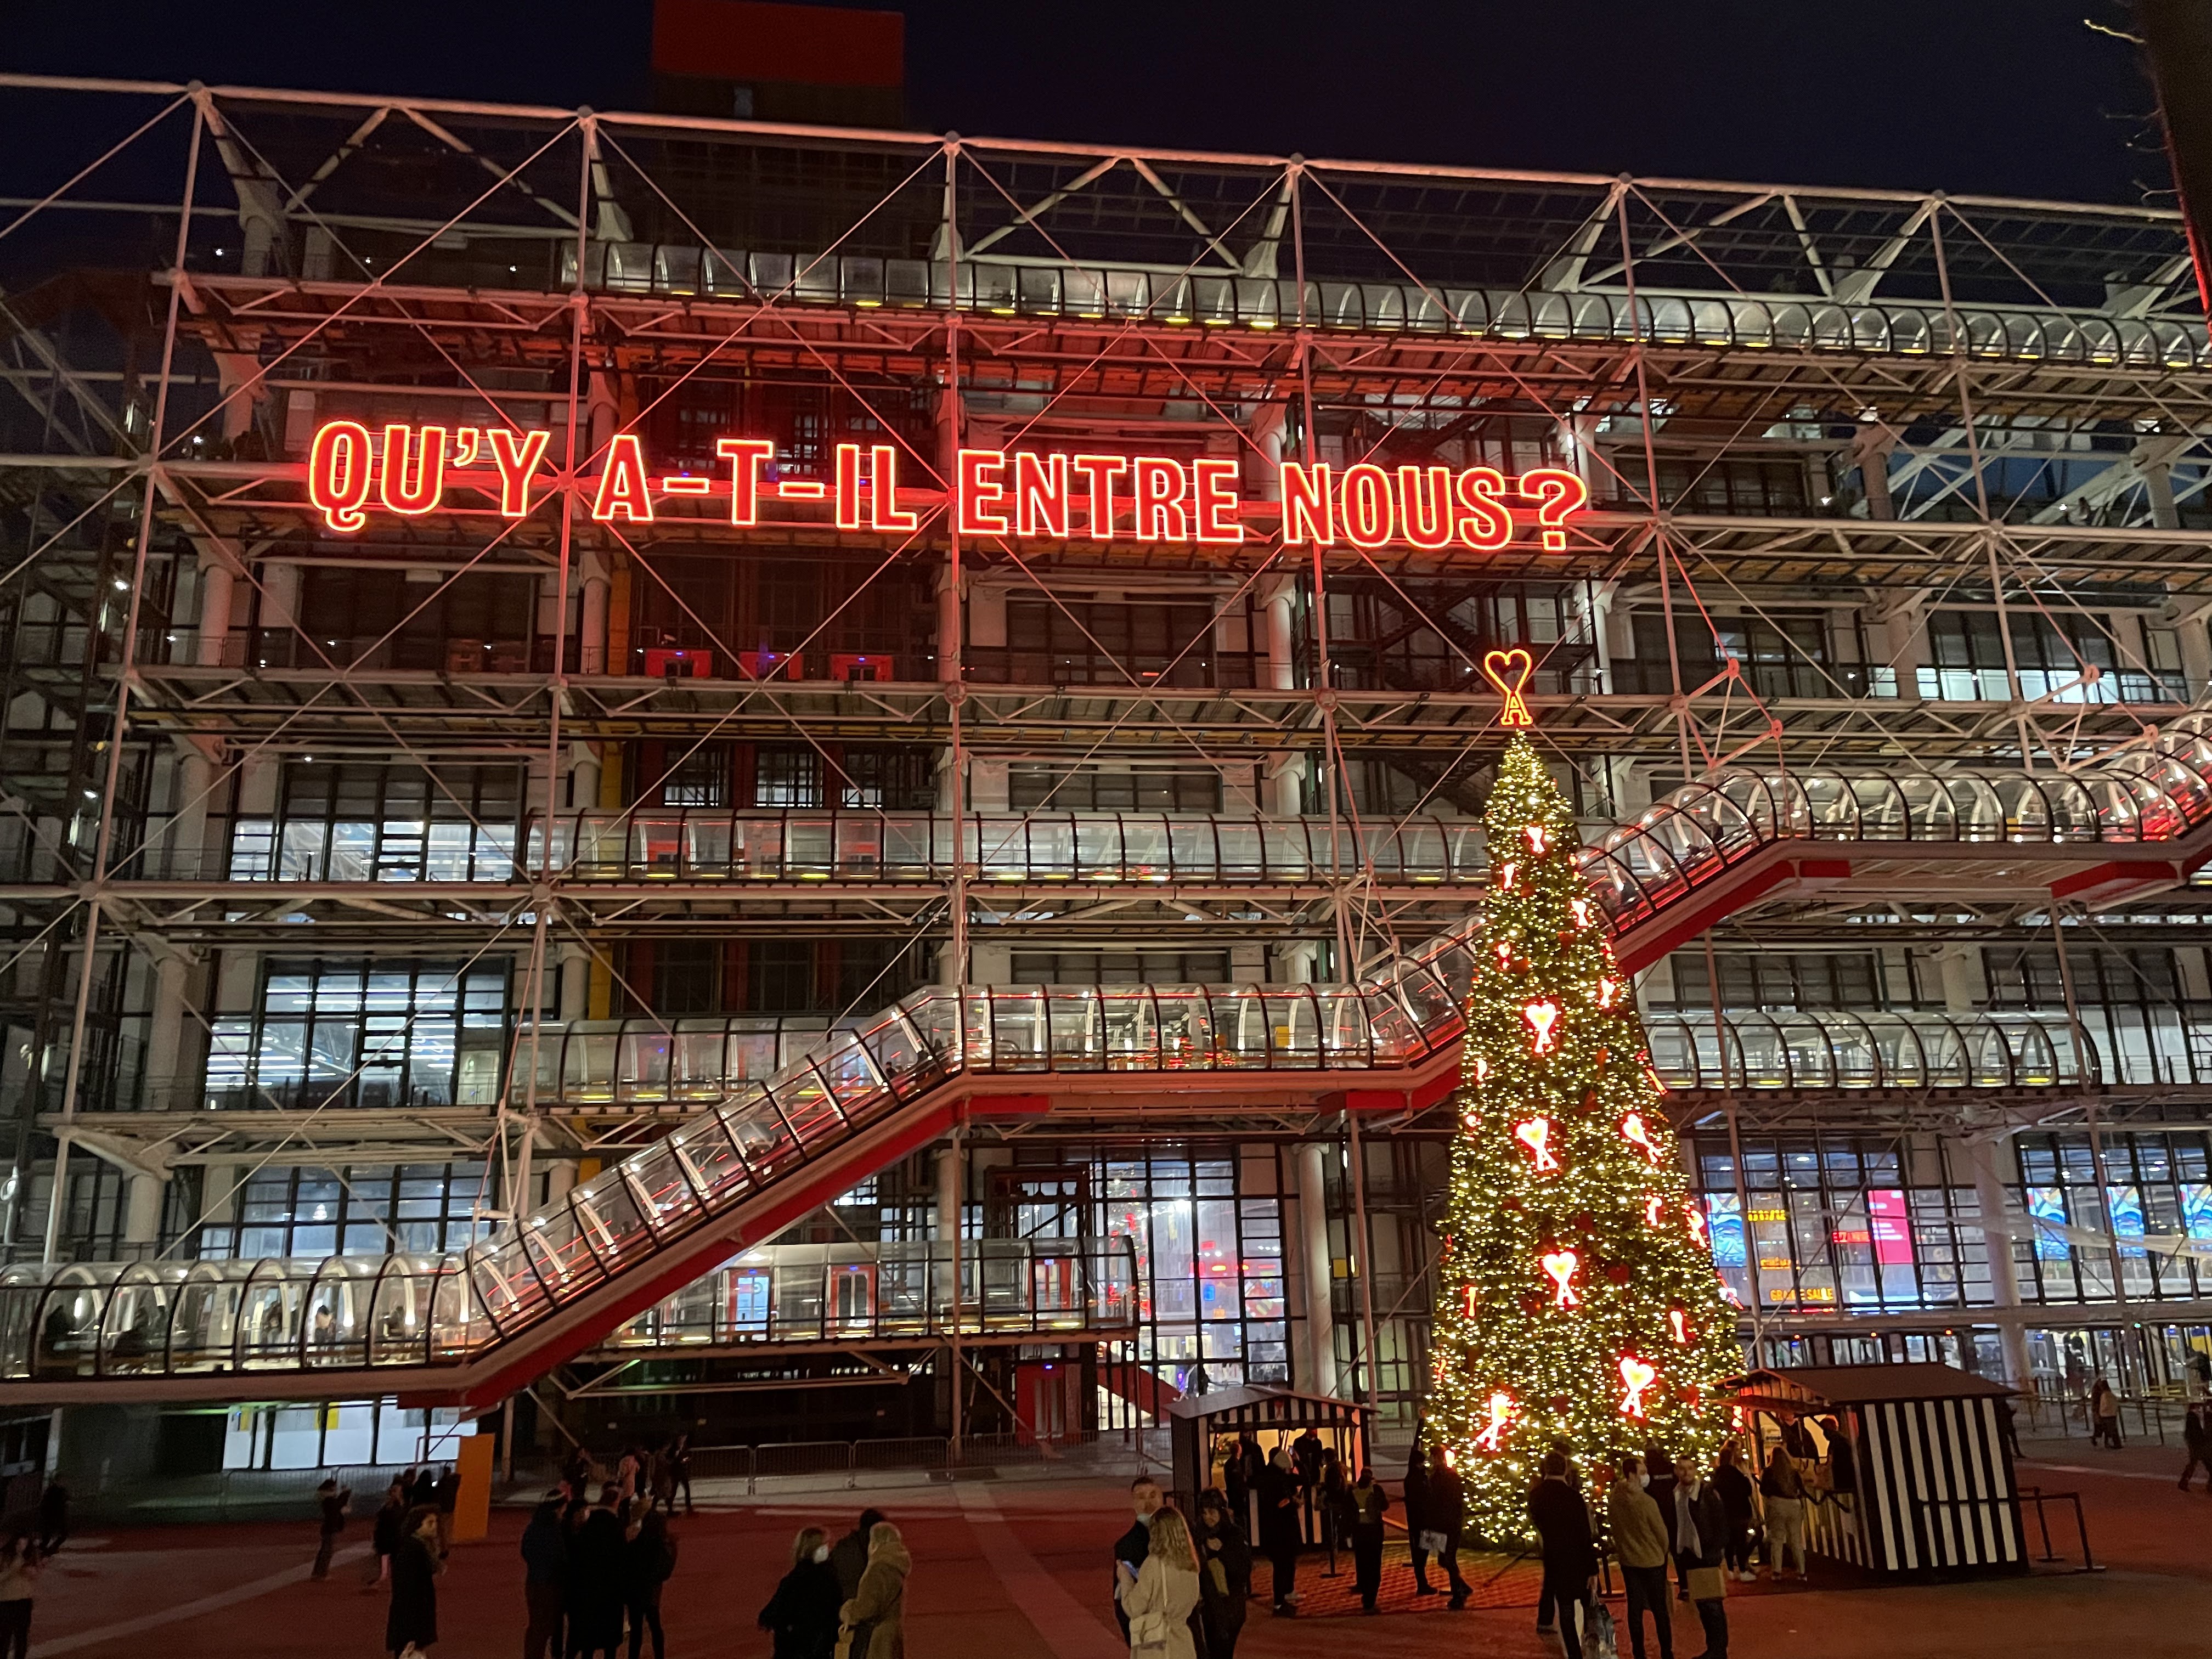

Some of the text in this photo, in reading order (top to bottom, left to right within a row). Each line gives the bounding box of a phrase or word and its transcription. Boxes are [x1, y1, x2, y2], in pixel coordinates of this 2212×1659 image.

[591, 434, 918, 531] A-T-IL
[957, 449, 1244, 544] ENTRE
[1279, 461, 1588, 551] NOUS?
